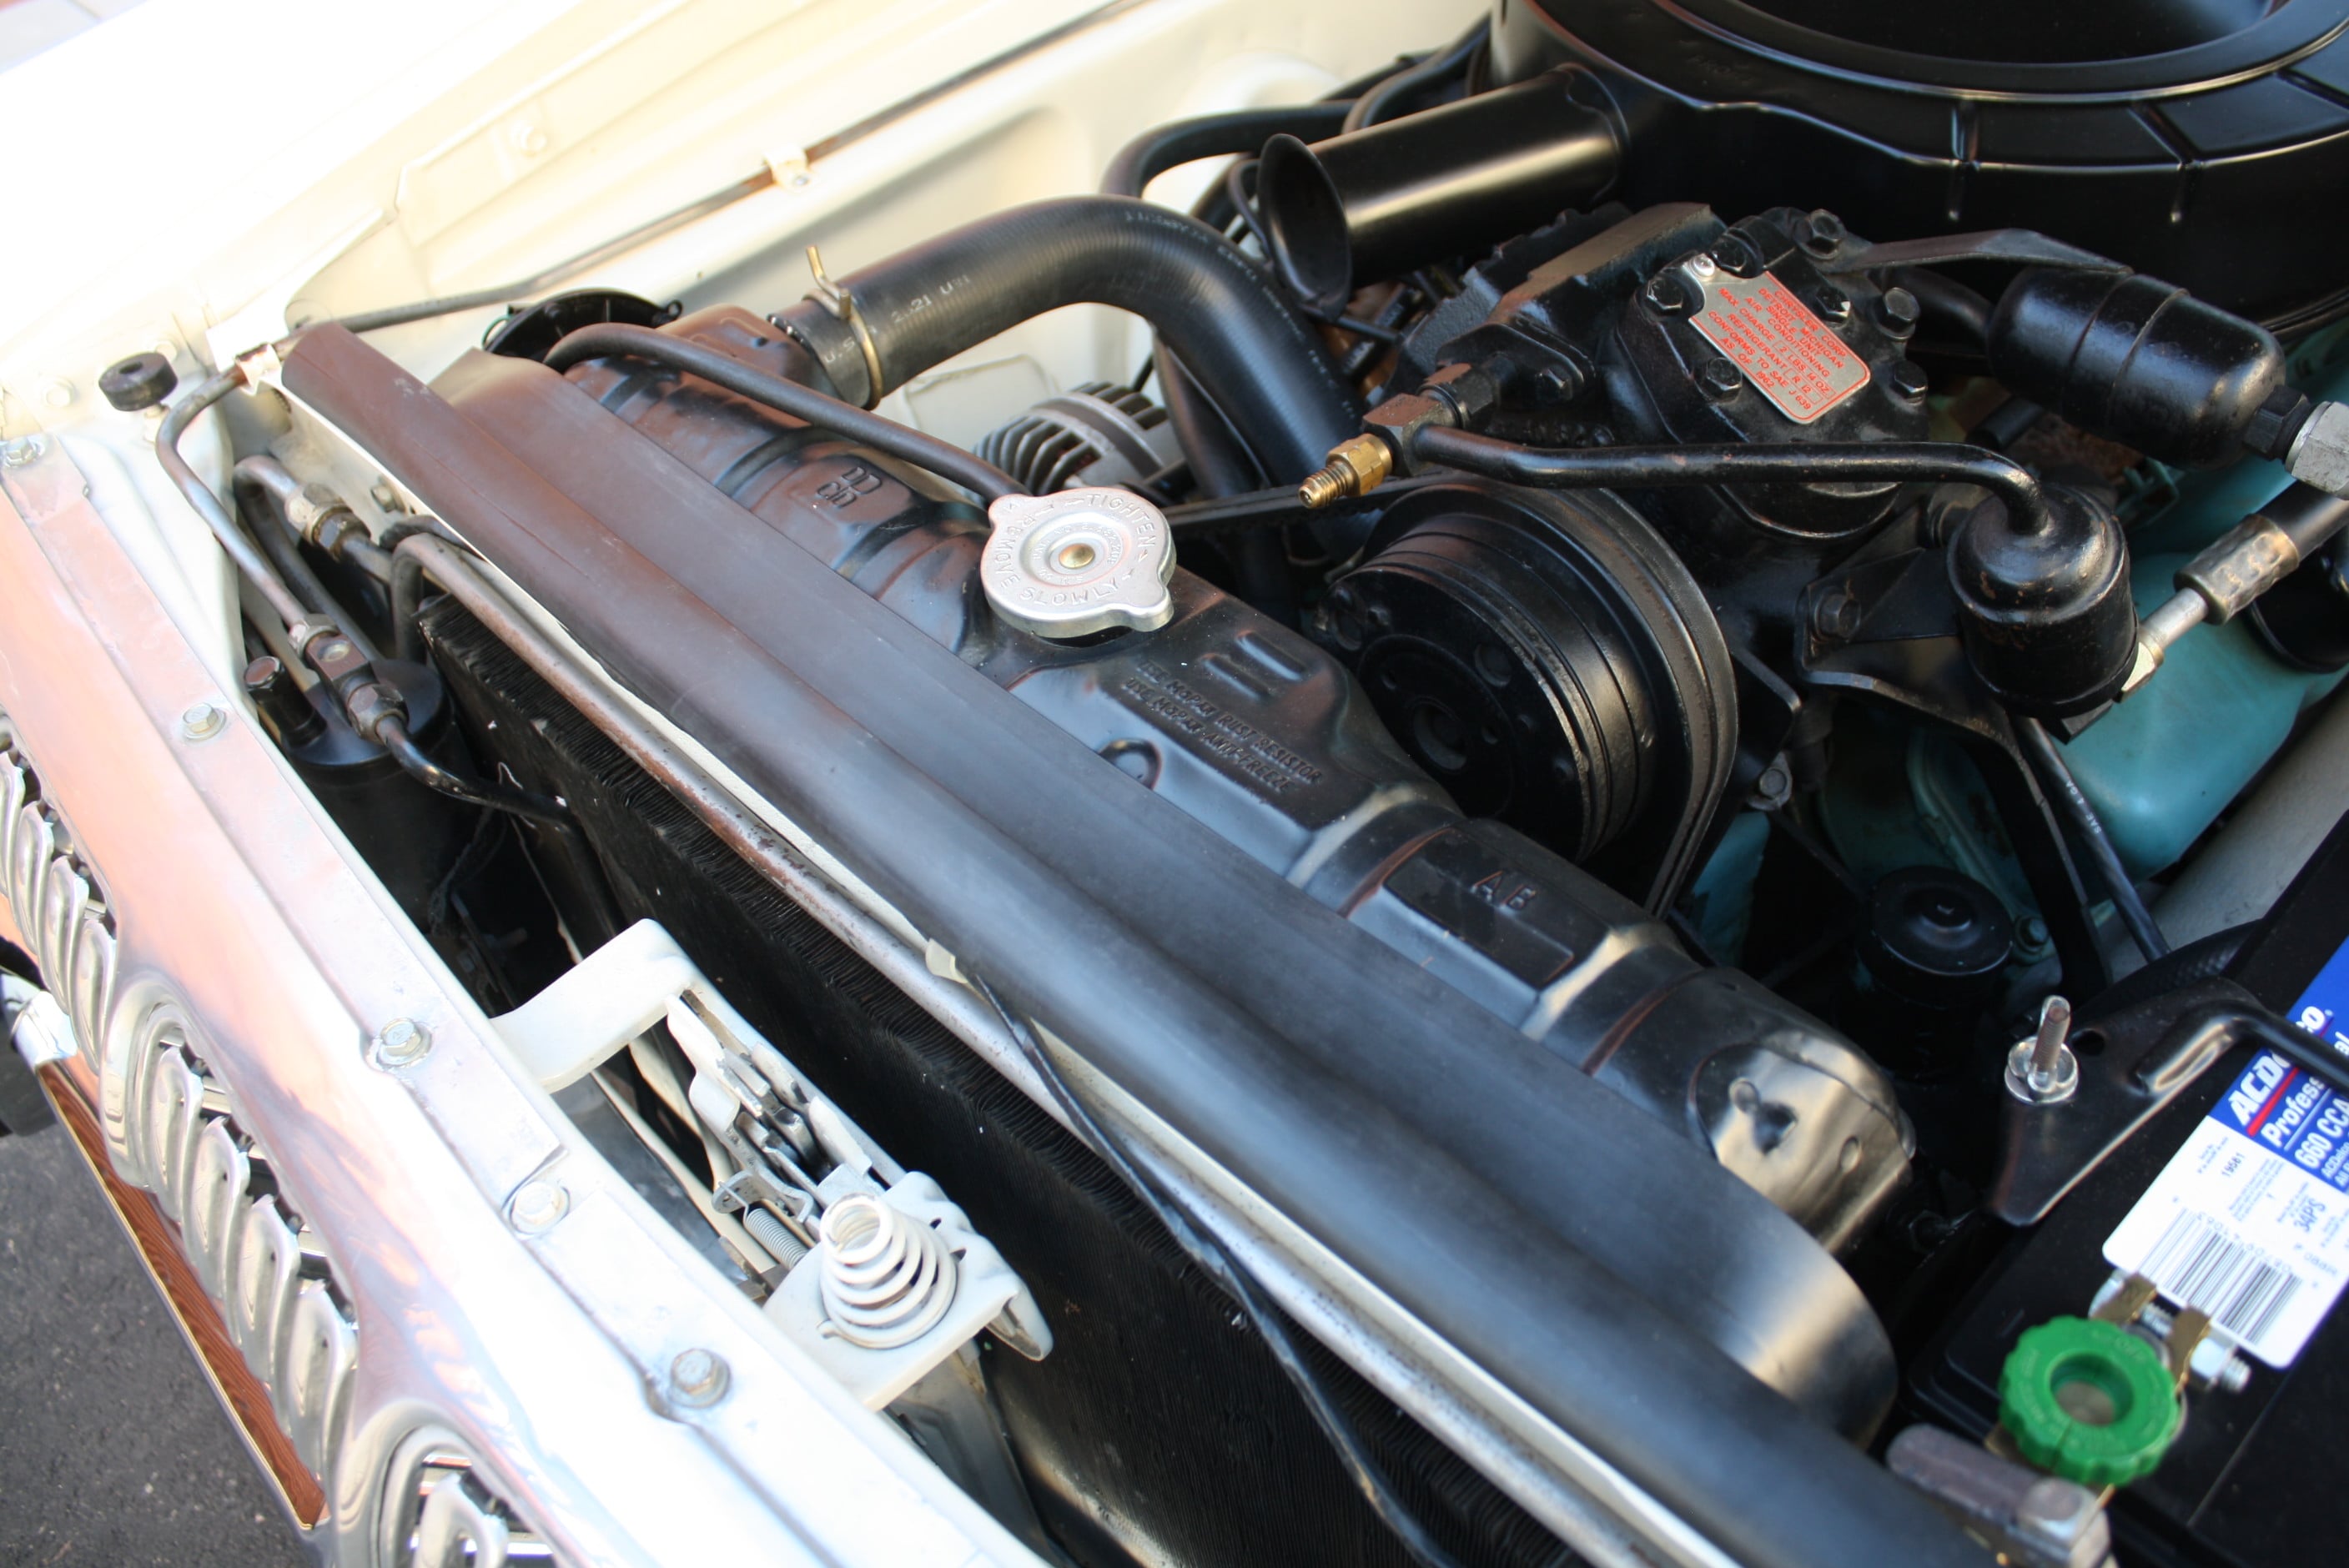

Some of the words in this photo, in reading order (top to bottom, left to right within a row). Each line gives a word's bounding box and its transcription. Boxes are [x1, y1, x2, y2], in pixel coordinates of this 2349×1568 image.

[1739, 307, 1775, 341] CHARGE
[1745, 296, 1763, 313] AIR
[1768, 318, 1830, 378] CONDITIONING
[1758, 288, 1795, 321] DETROIT
[1801, 327, 1844, 369] MICHIGAN
[1766, 305, 1796, 334] SINGLE
[1774, 289, 1819, 332] CHRYSLER
[1708, 310, 1755, 355] CONFORMS
[1757, 357, 1770, 369] TO
[1771, 369, 1787, 388] SAE
[1795, 394, 1812, 410] 639
[1720, 337, 1735, 350] AS
[1738, 352, 1752, 364] OF
[1757, 370, 1776, 388] 1962
[1728, 313, 1787, 369] REFRIGERANT
[1793, 375, 1801, 384] R
[1801, 384, 1811, 393] 12
[1086, 493, 1157, 549] TIGHTEN
[994, 513, 1036, 589] REMOVE
[1019, 578, 1120, 606] SLOWLY
[1122, 677, 1152, 703] USE
[1215, 711, 1257, 742] RUST
[1250, 731, 1324, 785] RESISTOR
[2295, 1132, 2332, 1168] 660
